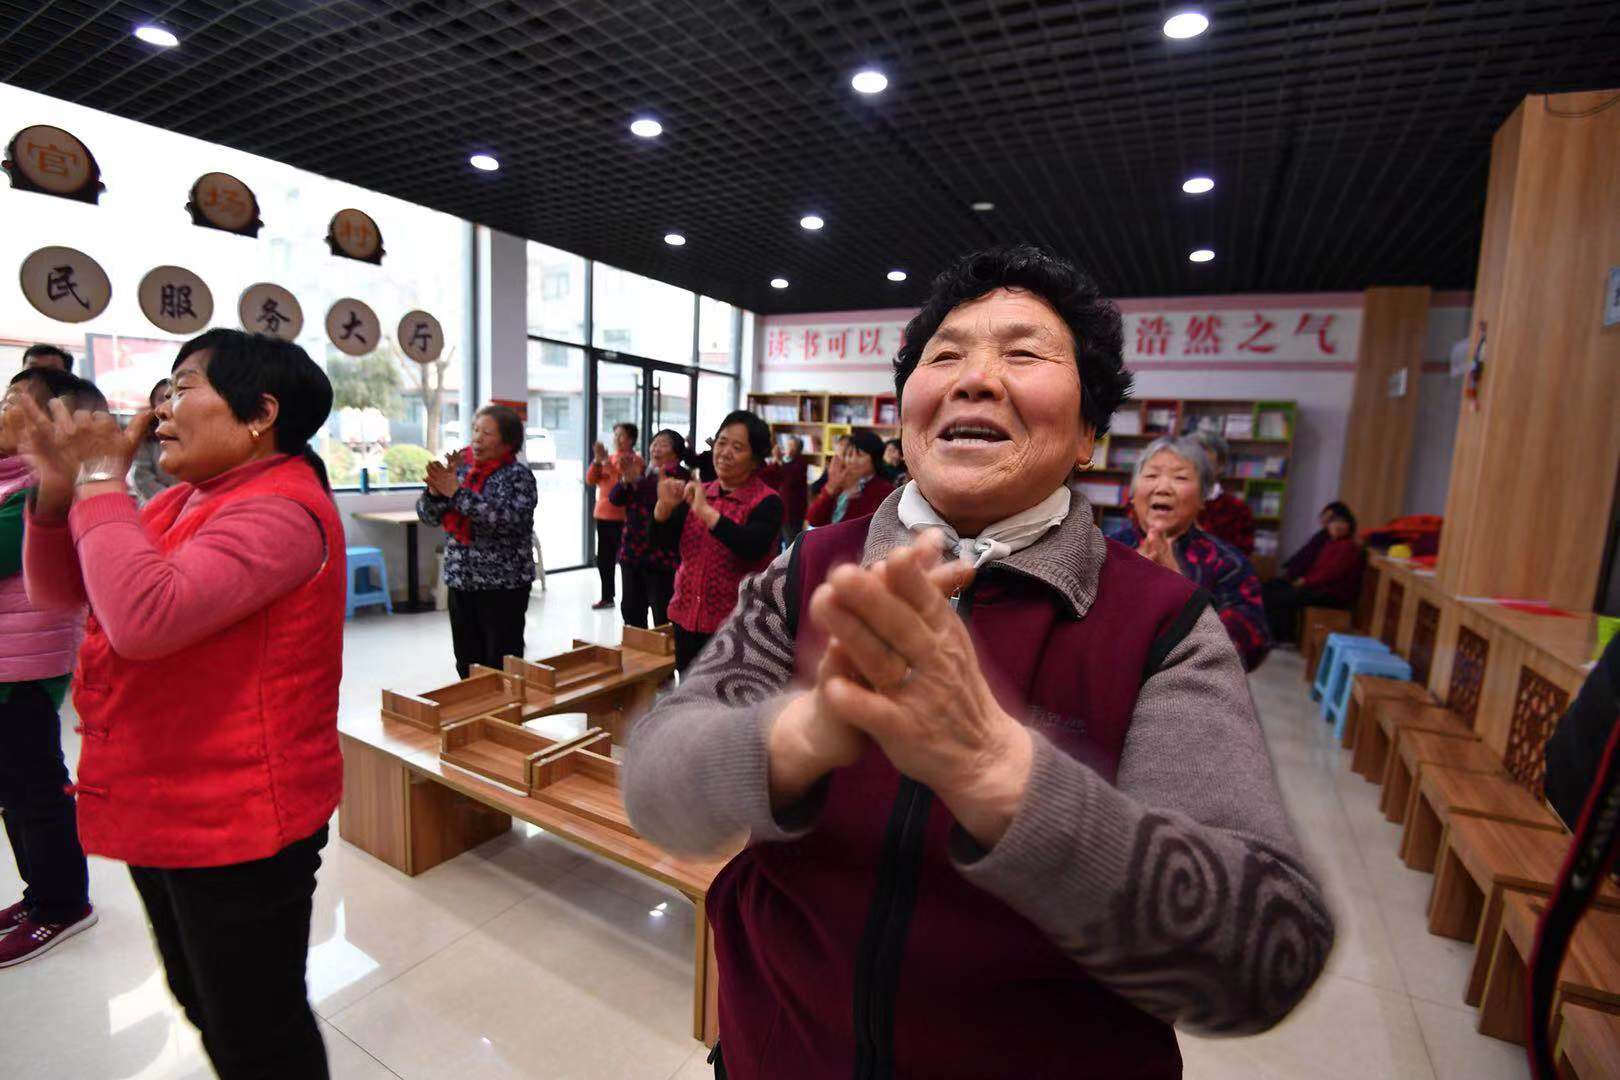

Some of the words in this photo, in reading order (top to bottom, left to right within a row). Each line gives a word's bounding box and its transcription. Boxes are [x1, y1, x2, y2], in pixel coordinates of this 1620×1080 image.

[47, 265, 433, 354] 民服务大厅
[1136, 312, 1339, 356] 浩然之气
